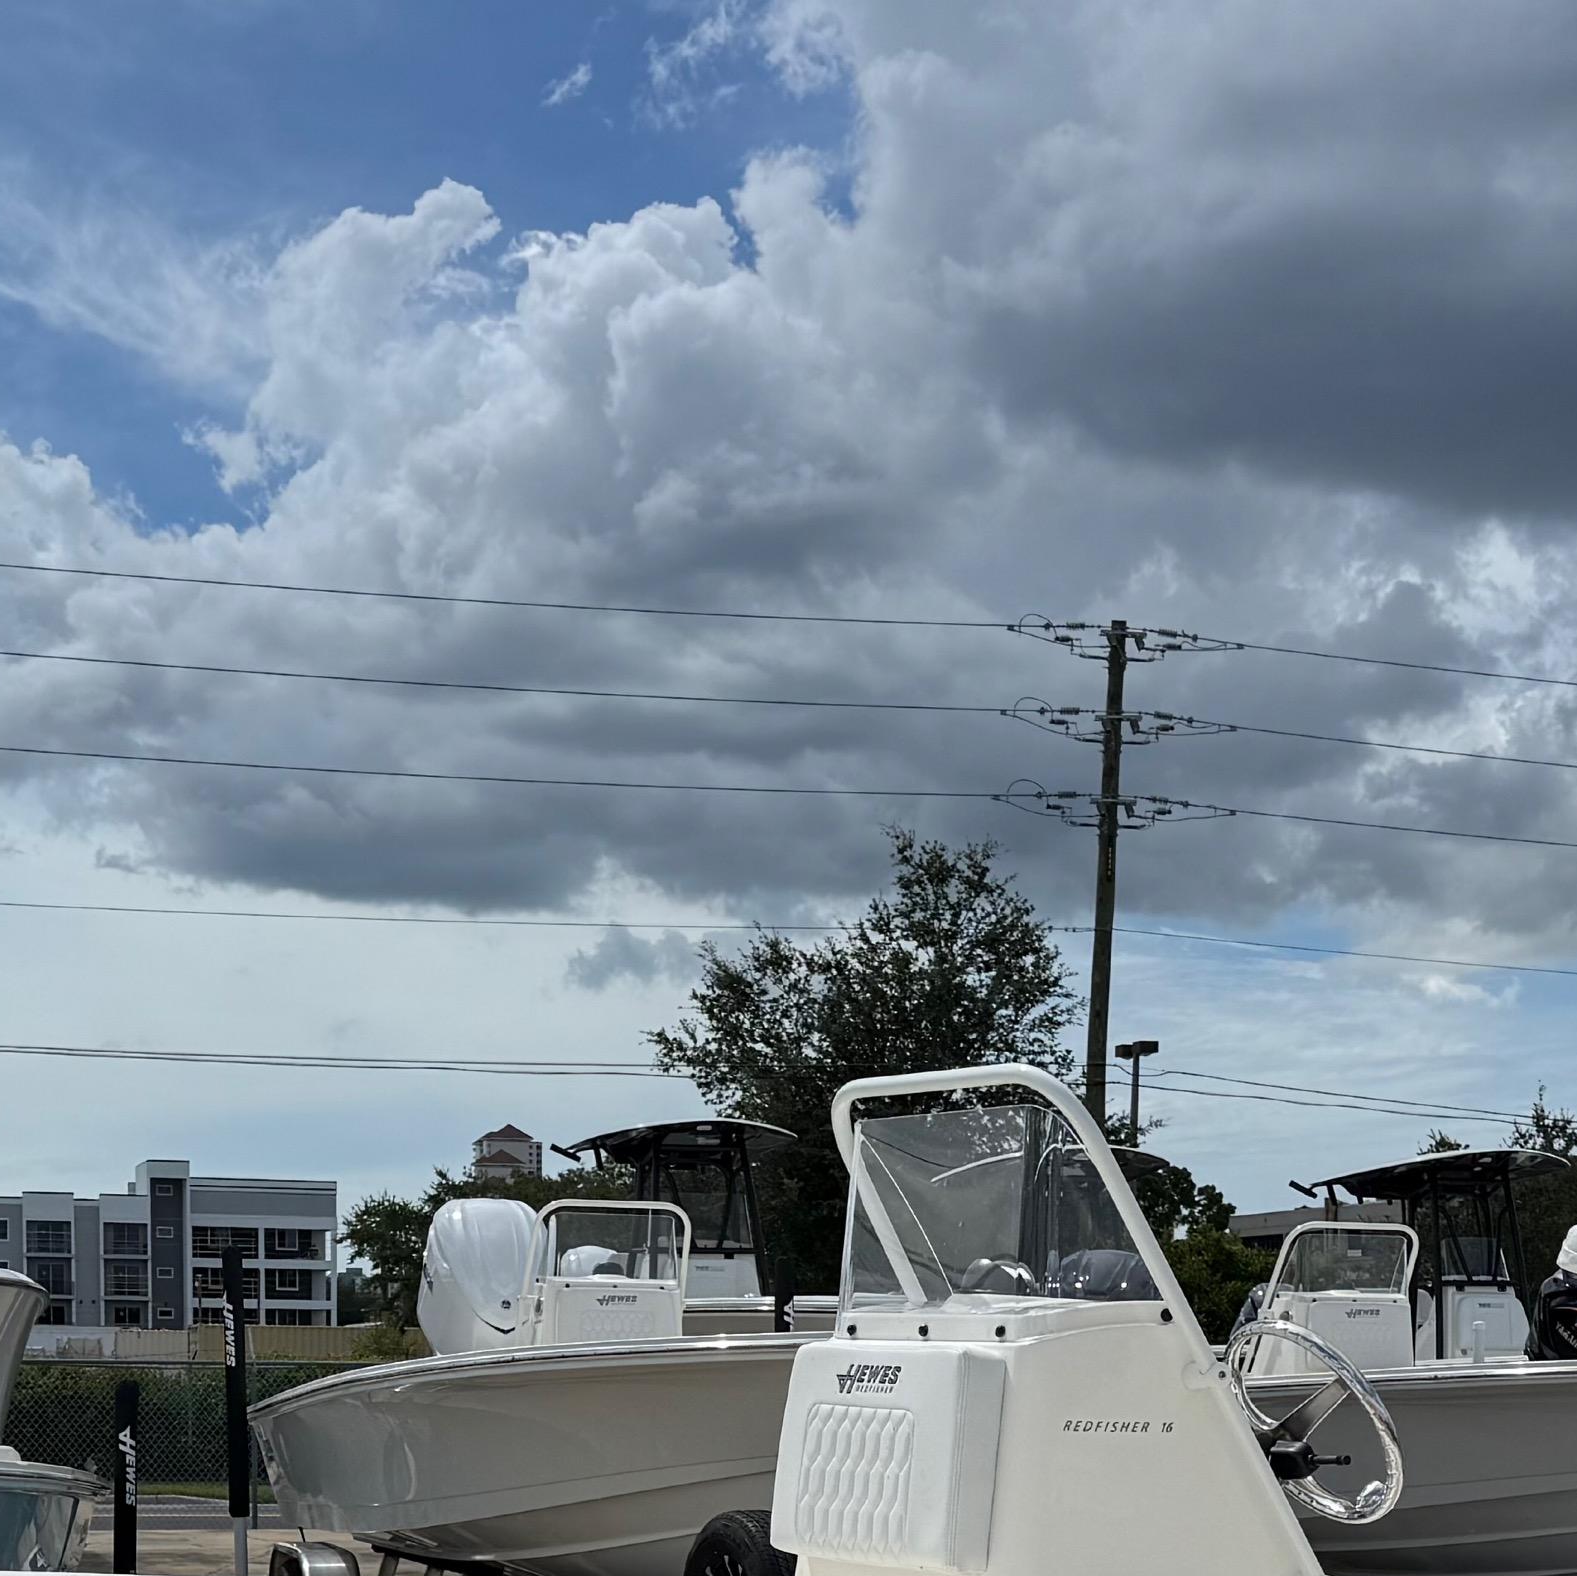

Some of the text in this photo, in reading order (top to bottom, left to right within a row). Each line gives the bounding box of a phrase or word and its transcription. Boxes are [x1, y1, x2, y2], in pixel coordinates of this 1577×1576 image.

[223, 1290, 235, 1367] HEWES
[836, 1364, 903, 1394] HEWES
[1063, 1419, 1174, 1433] REDFISHER 16
[118, 1425, 137, 1507] HEWES
